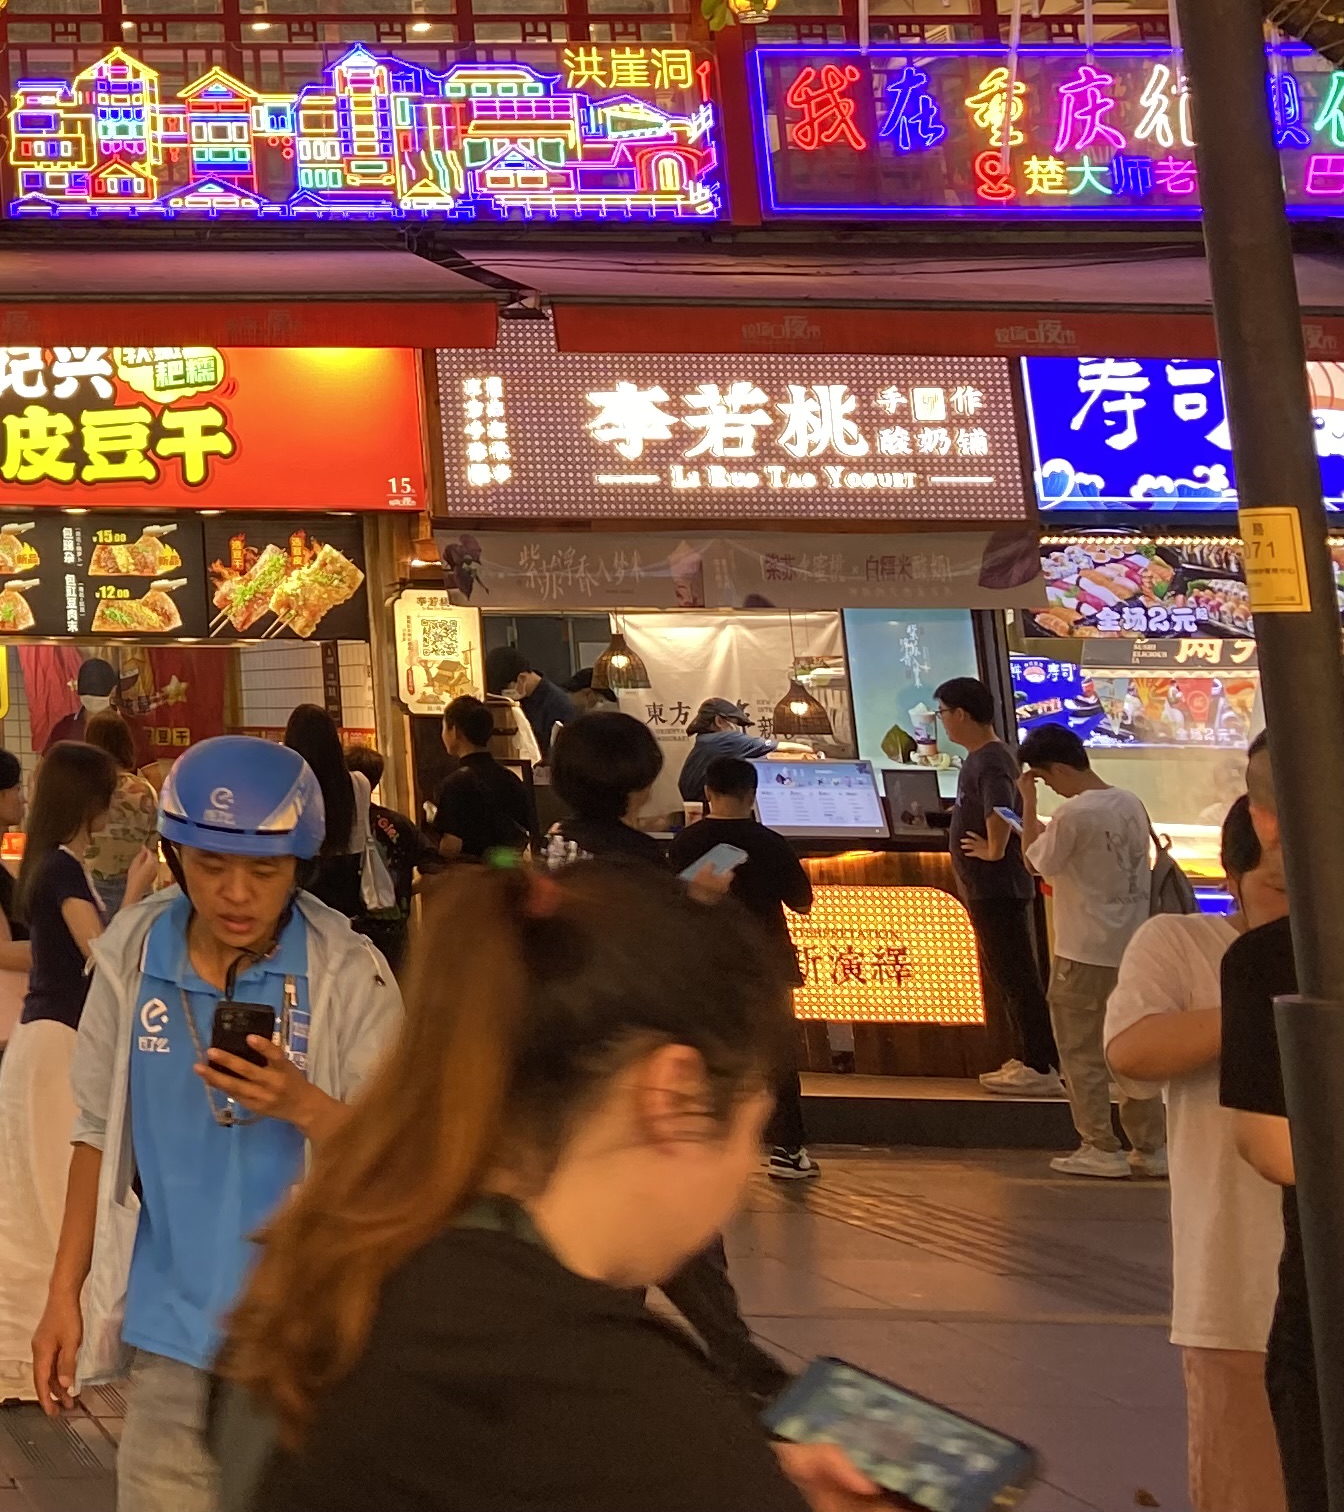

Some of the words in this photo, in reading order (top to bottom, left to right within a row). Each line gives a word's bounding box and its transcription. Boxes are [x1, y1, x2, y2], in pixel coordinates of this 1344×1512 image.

[563, 47, 694, 90] 洪崖洞
[585, 381, 870, 461] 李若桃
[877, 425, 990, 456] 酸奶铺
